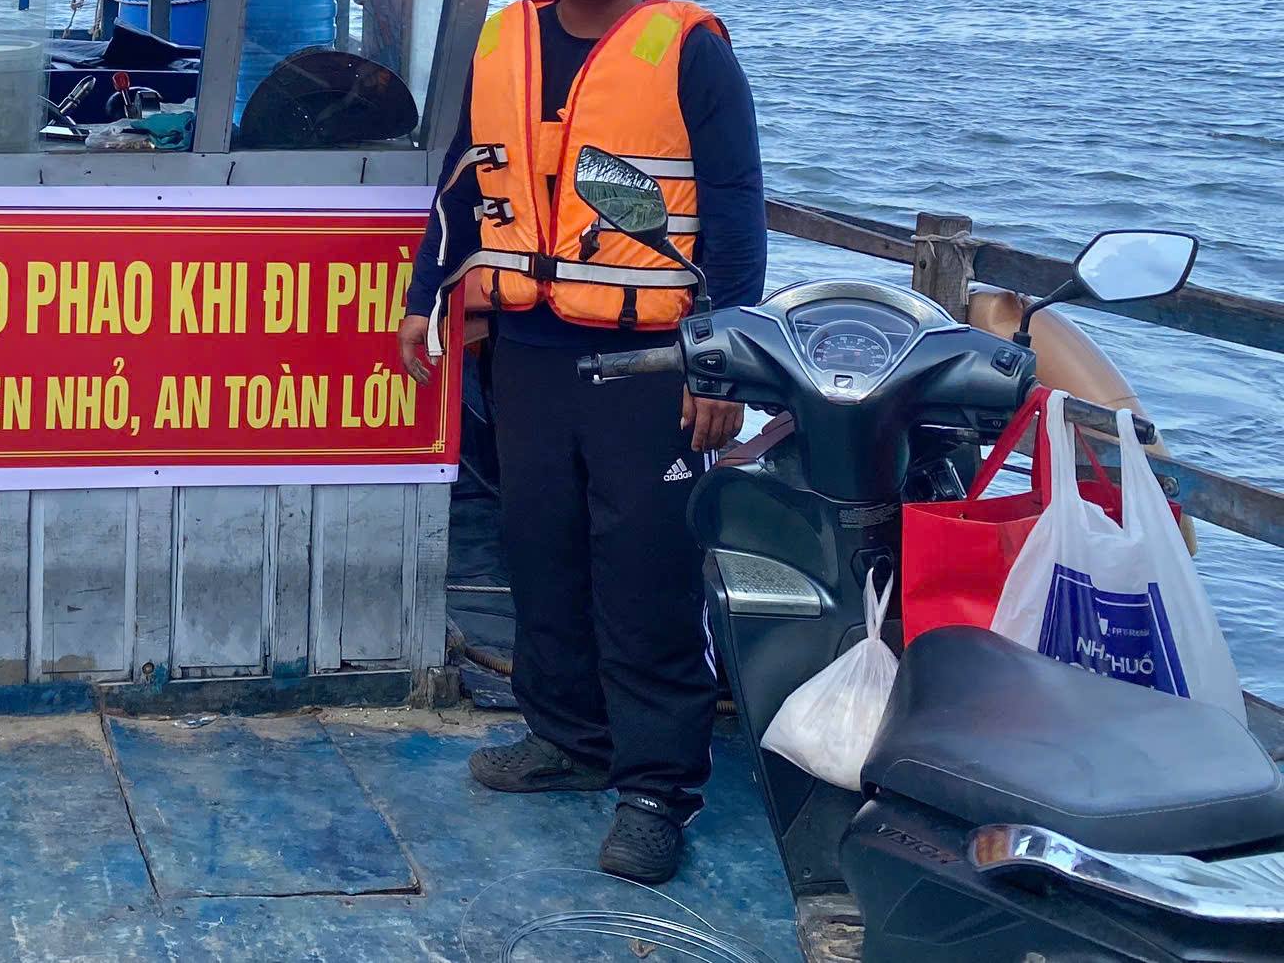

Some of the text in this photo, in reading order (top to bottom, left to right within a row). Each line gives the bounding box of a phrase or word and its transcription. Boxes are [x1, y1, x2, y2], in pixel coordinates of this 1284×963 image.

[26, 261, 153, 335] PHAO
[170, 262, 248, 334] KHI
[263, 261, 311, 334] ĐI
[326, 245, 414, 334] PHÀ
[45, 355, 141, 437] NHỎ,
[154, 376, 212, 430] AN
[224, 362, 329, 430] TOÀN
[341, 362, 417, 428] LỚN
[663, 470, 693, 482] adidas
